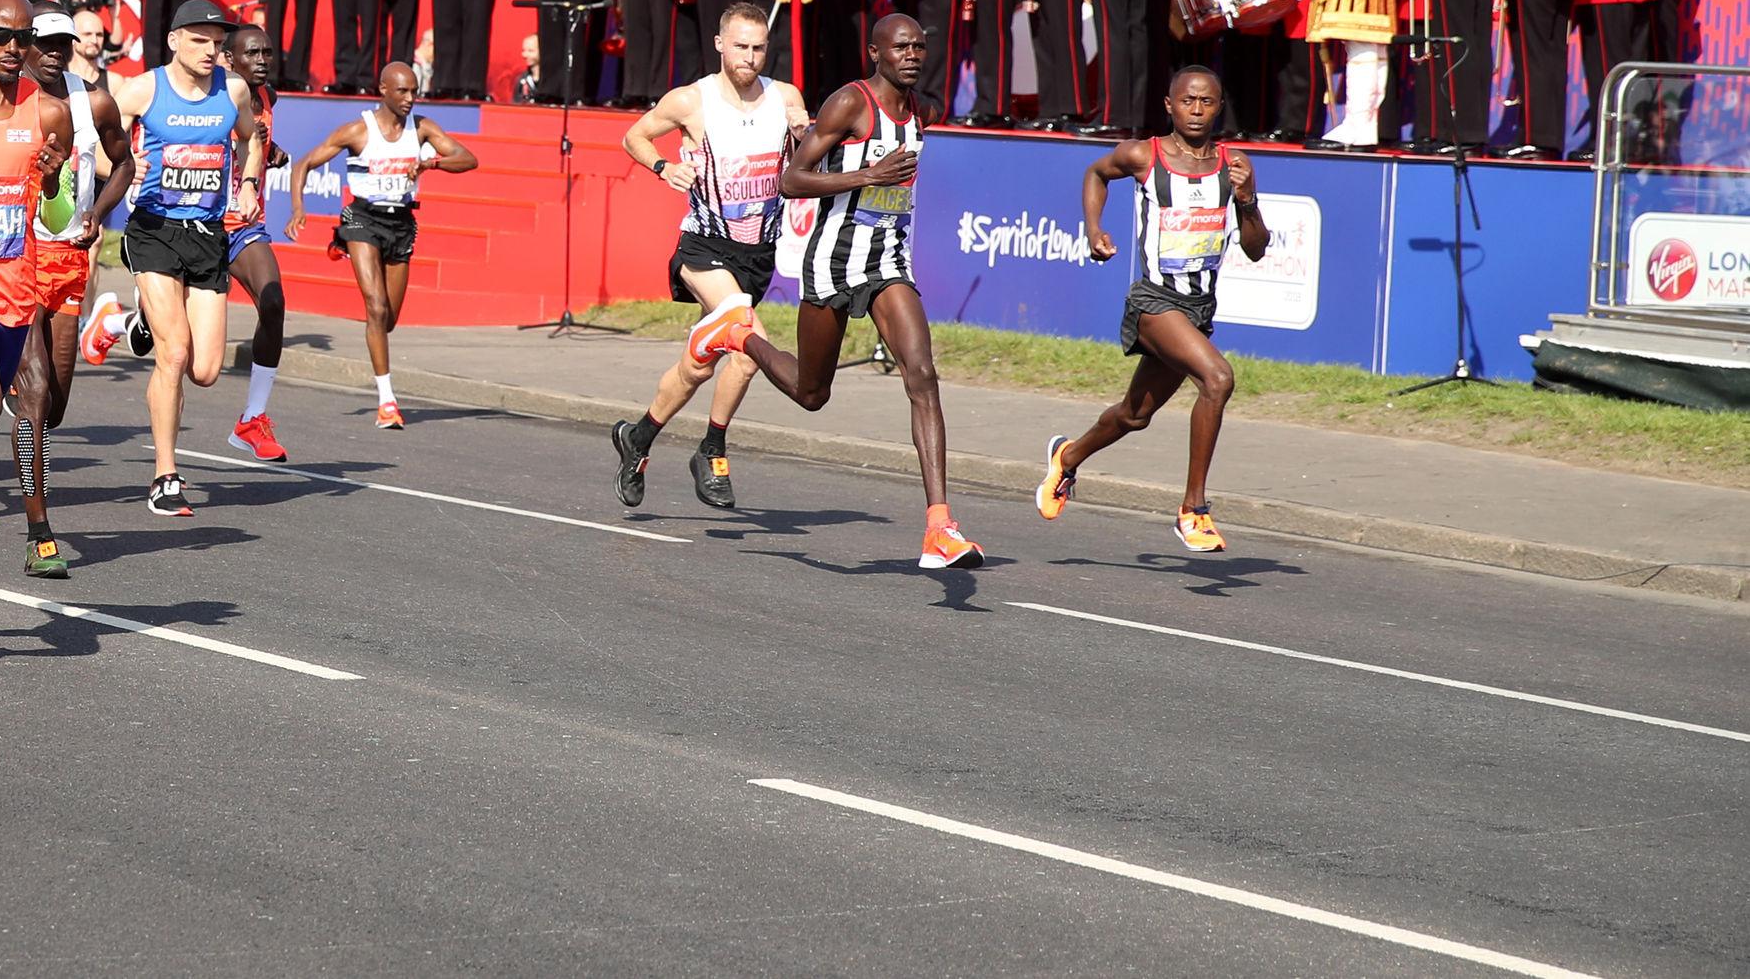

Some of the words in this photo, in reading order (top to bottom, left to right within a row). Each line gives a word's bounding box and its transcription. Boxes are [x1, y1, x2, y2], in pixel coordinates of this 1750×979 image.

[167, 114, 223, 127] CARDIFF
[193, 151, 221, 162] money
[750, 158, 778, 169] money
[162, 170, 221, 191] CLOWES
[724, 177, 778, 201] SCULLION
[861, 186, 905, 210] PACE
[1193, 214, 1224, 224] money
[957, 211, 1106, 267] #SpiritofLond
[1650, 244, 1696, 294] Virgin
